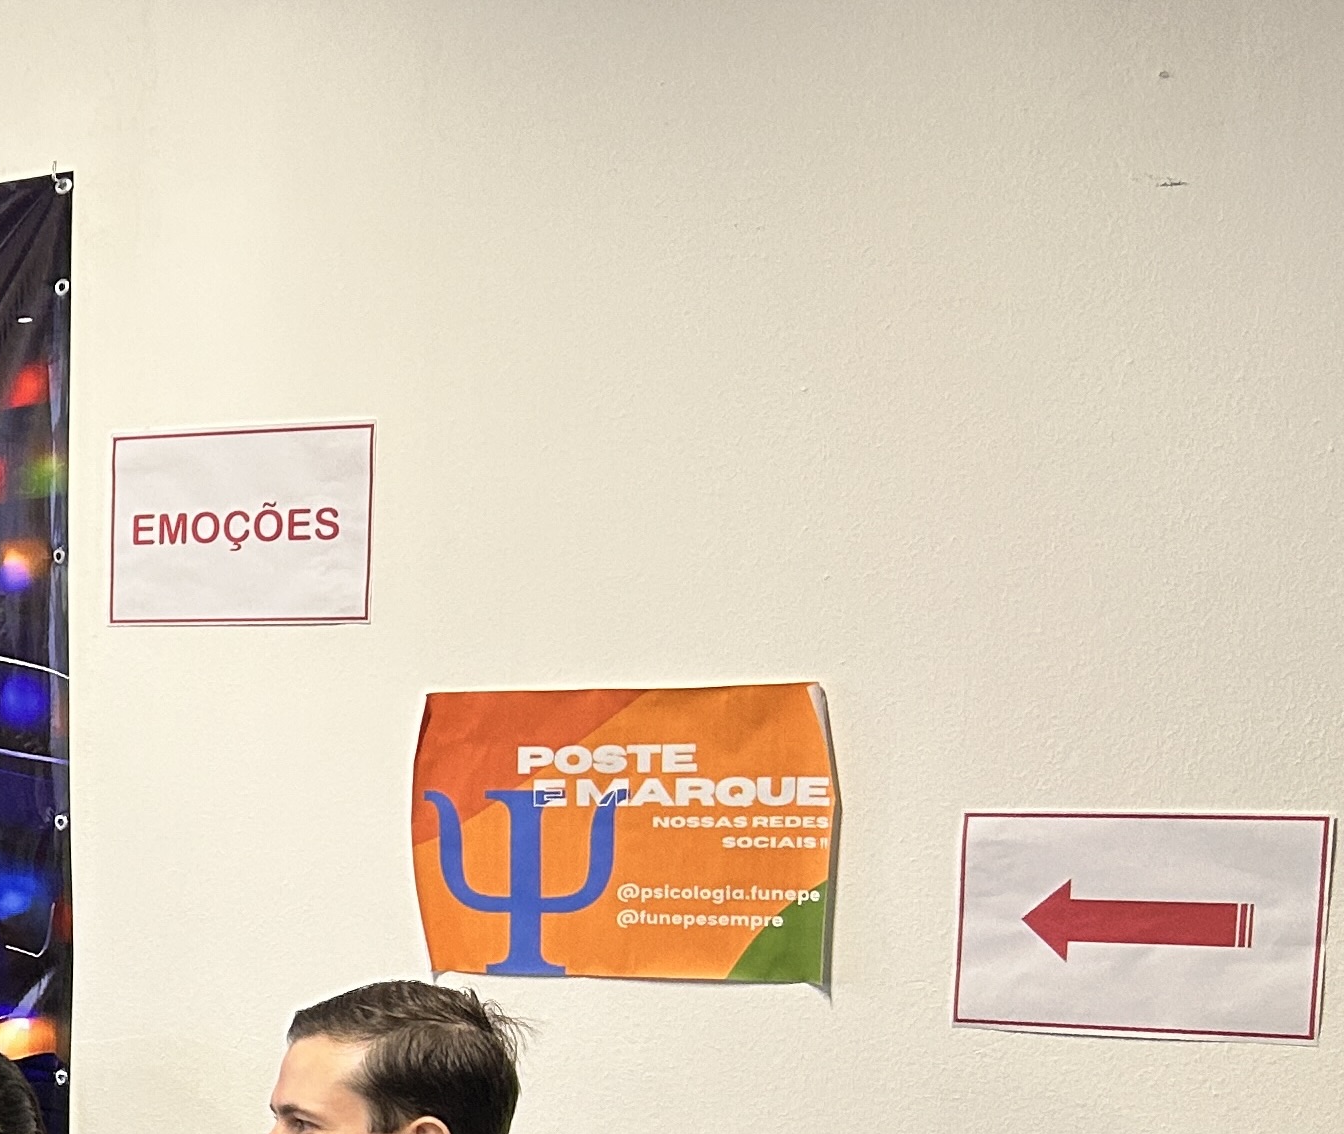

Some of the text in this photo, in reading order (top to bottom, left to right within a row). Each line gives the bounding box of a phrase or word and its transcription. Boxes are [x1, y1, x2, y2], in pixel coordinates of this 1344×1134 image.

[132, 501, 341, 552] EMOÇÕES
[517, 743, 698, 775] POSTE
[533, 775, 831, 808] E MARQUE
[652, 815, 830, 829] NOSSAS REDES
[721, 836, 817, 850] SOCIAIS
[616, 882, 821, 906] @psicologia.funepe
[616, 908, 785, 931] @funepesempre
